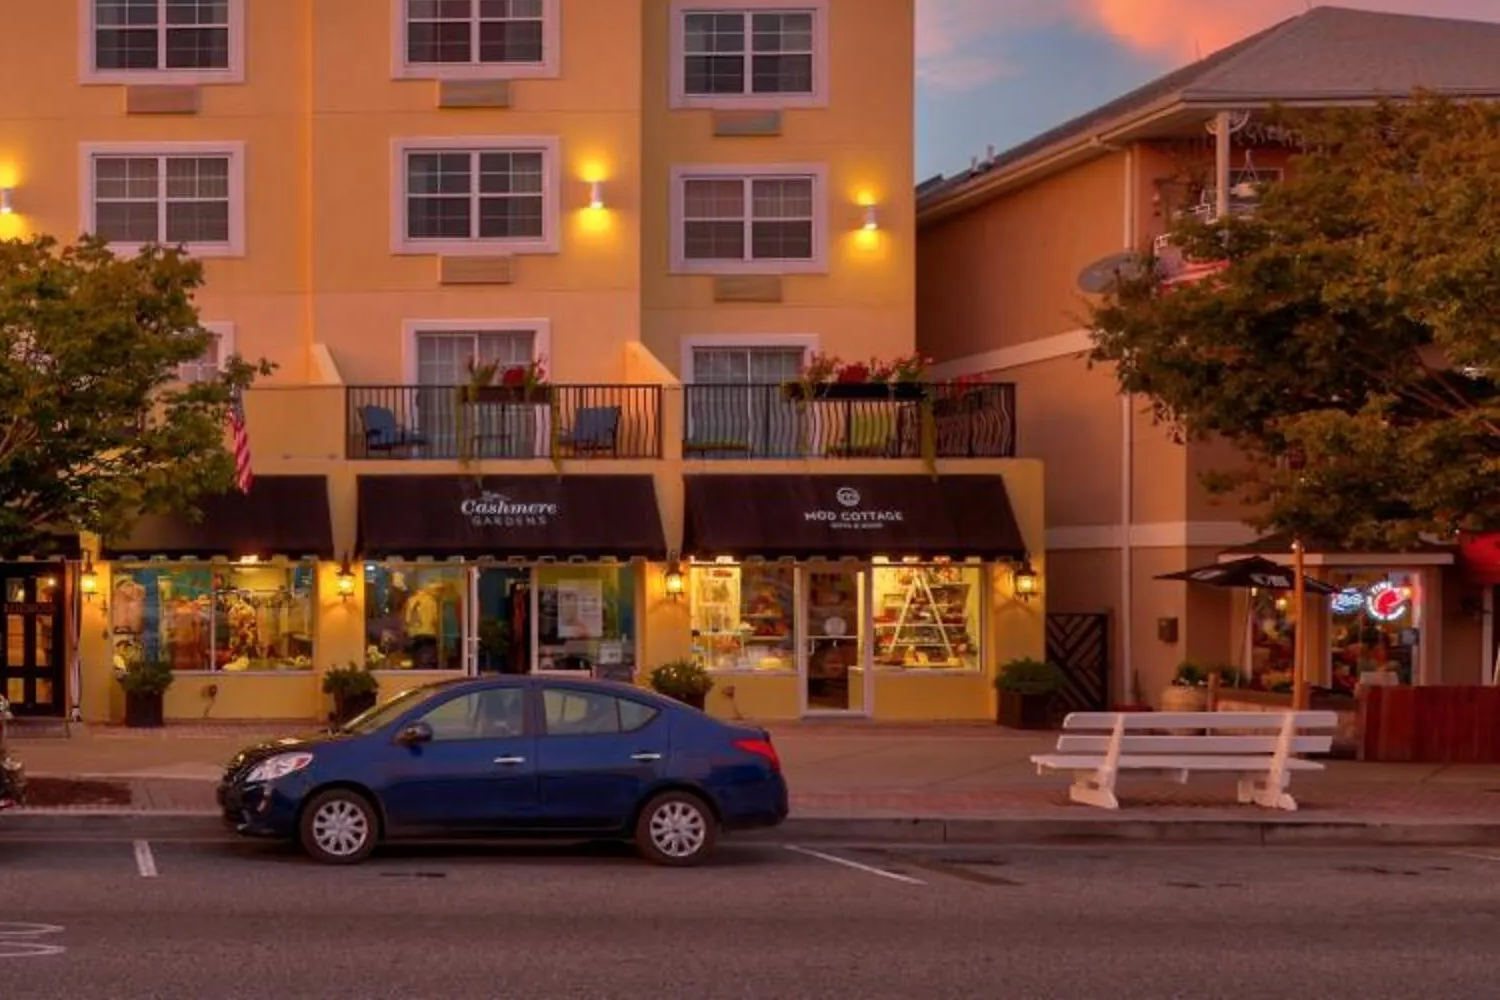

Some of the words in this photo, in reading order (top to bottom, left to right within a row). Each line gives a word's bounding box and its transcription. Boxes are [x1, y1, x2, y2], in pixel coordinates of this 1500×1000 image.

[461, 500, 557, 515] Cashmere
[804, 511, 836, 521] MOD
[841, 511, 903, 521] COTTAGE
